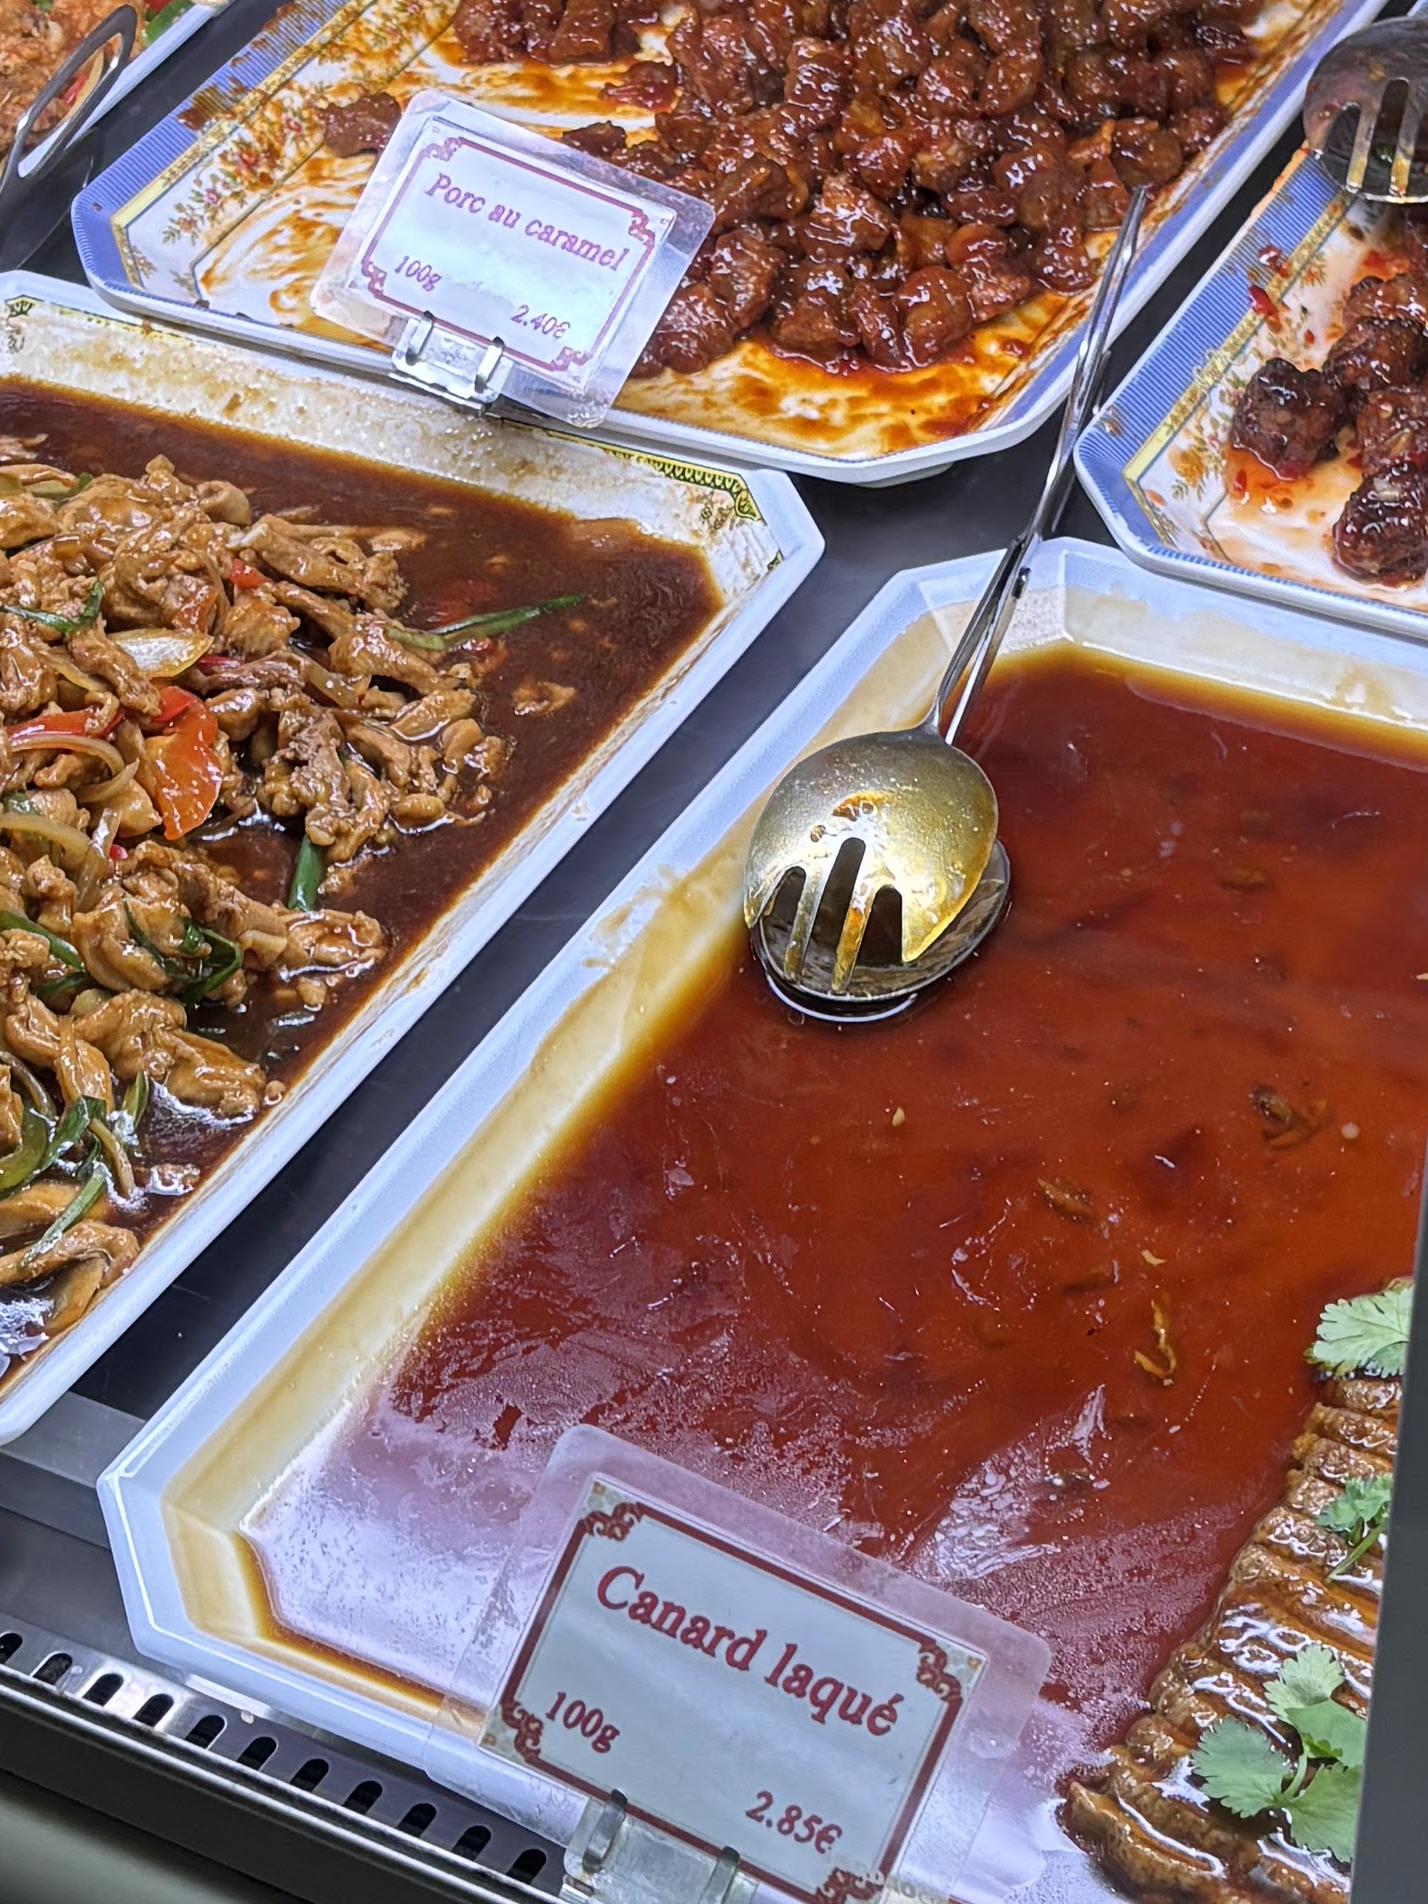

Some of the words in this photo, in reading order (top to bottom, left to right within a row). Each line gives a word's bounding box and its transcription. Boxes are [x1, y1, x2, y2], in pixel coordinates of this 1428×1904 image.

[424, 172, 486, 214] Porc
[488, 202, 521, 229] au
[525, 217, 631, 272] caramel
[394, 255, 442, 292] 100g
[510, 304, 571, 339] 2.40€
[596, 1565, 768, 1673] Canard
[763, 1643, 904, 1737] laqué
[544, 1691, 621, 1754] 100g
[745, 1790, 844, 1854] 2.85€
